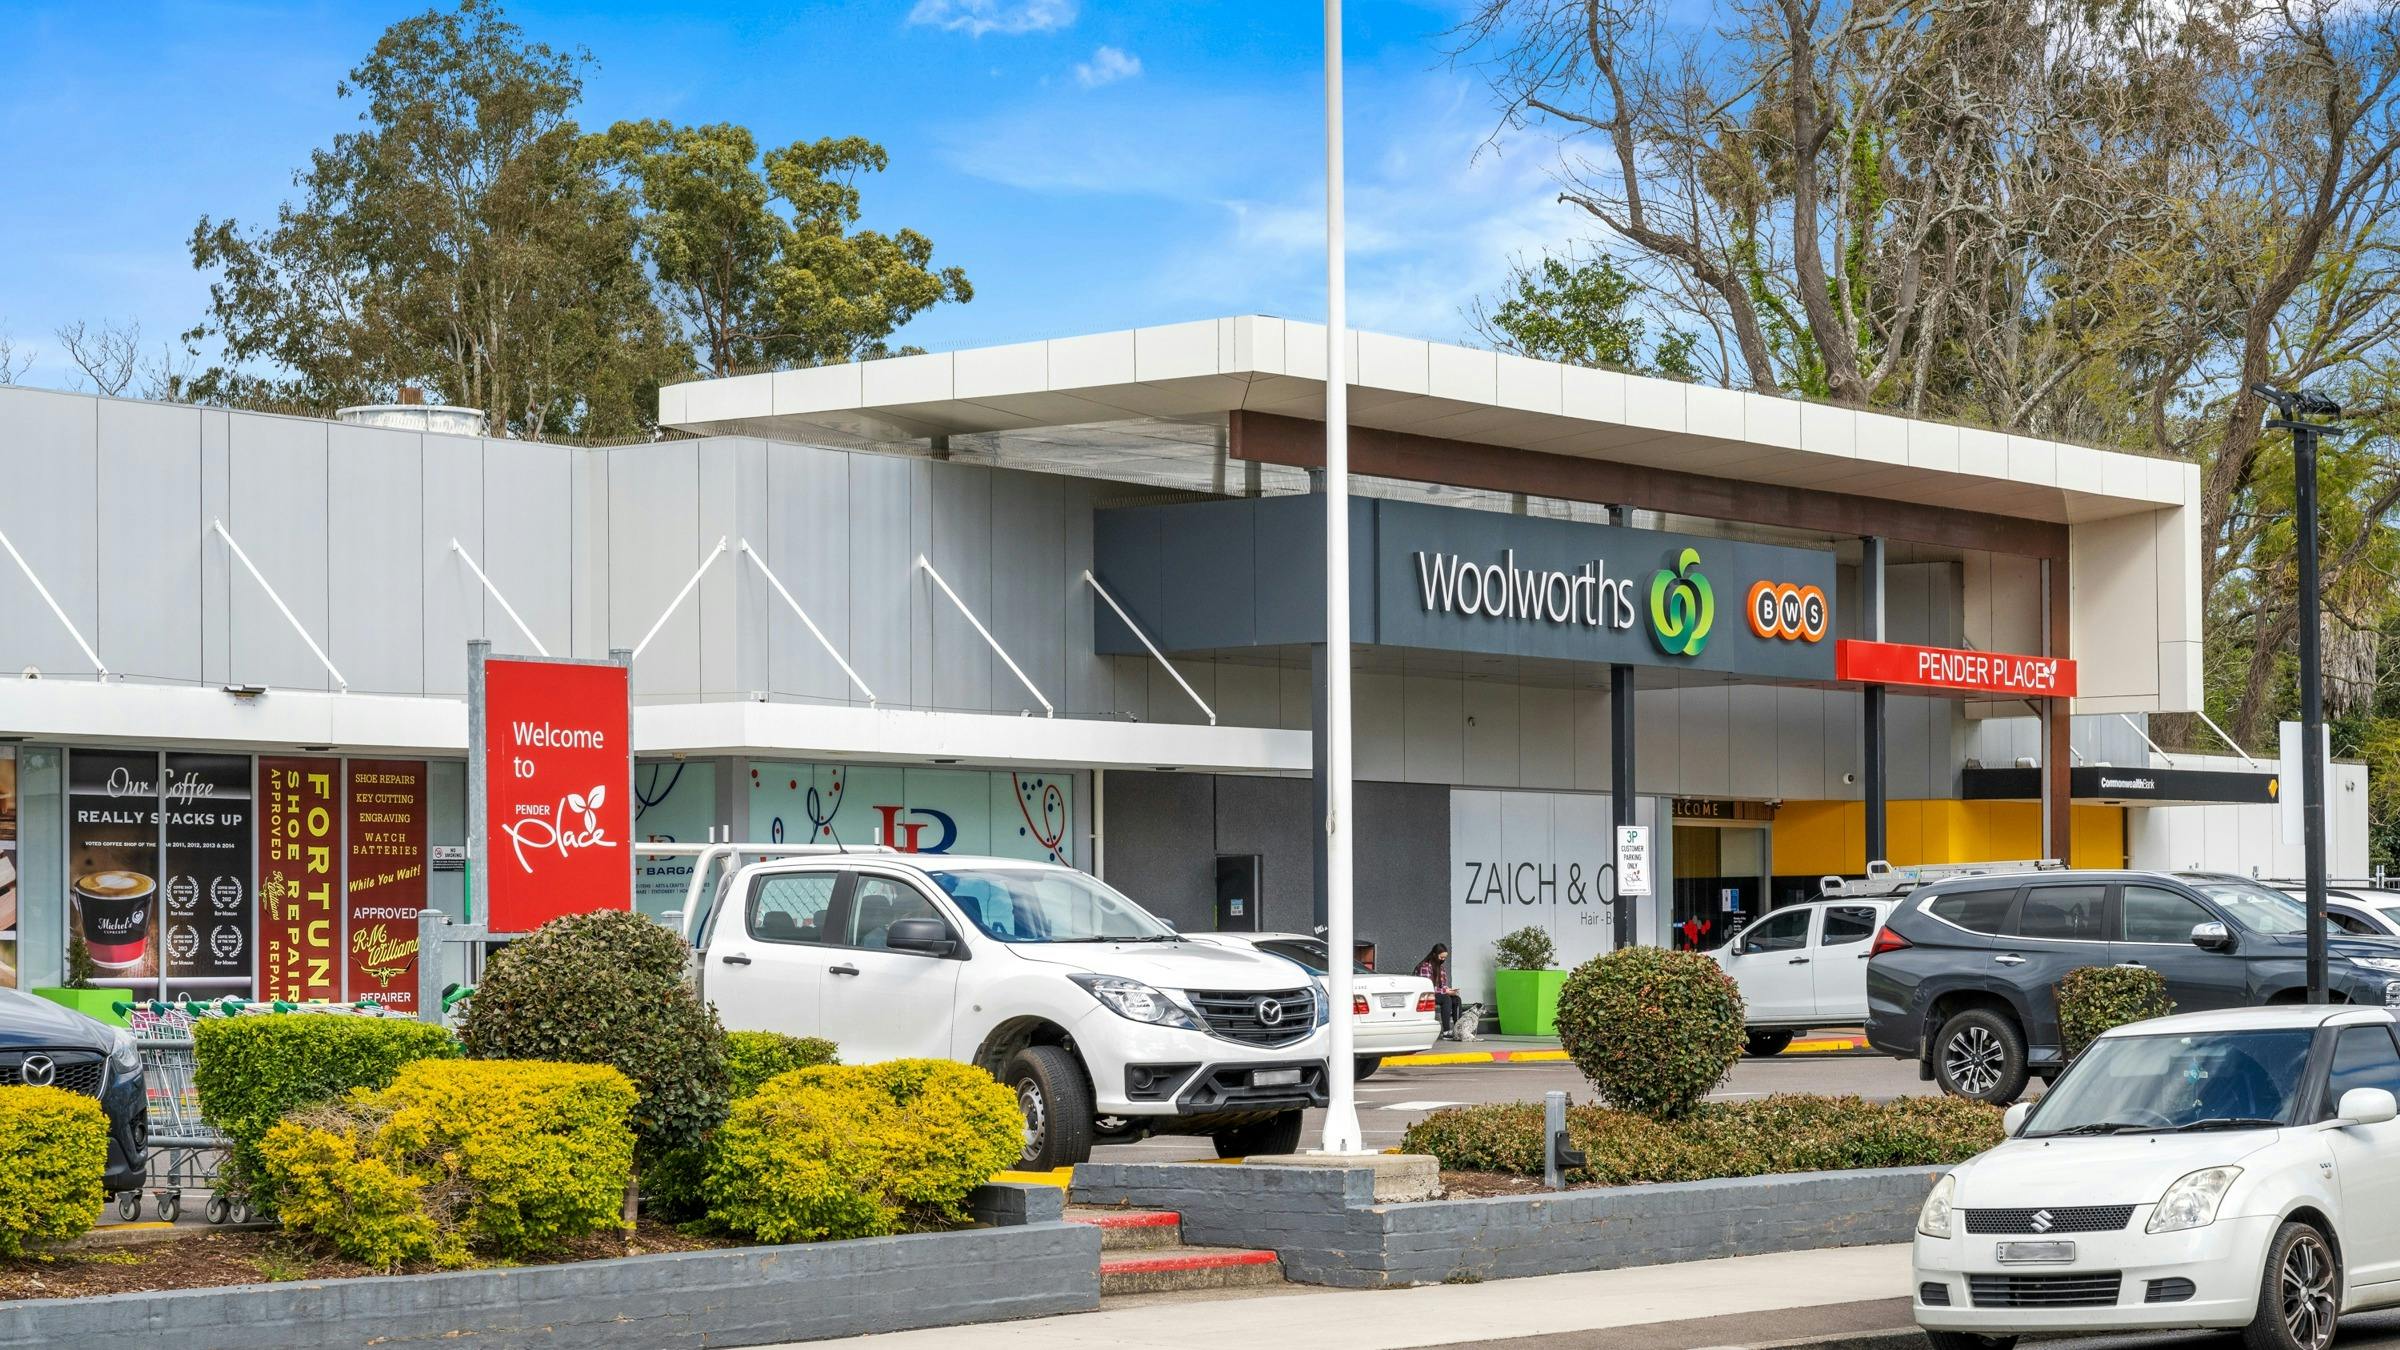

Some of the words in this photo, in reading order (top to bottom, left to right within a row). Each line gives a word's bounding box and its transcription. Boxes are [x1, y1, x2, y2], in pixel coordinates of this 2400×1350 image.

[1416, 549, 1635, 629] Woolworths
[1919, 652, 1989, 684] PENDER
[1994, 659, 2046, 688] PLACE
[512, 721, 604, 749] Welcome
[513, 756, 535, 778] to
[107, 767, 149, 798] Our
[355, 774, 378, 784] SHOE
[380, 774, 415, 785] REPAIRS
[356, 794, 373, 803] KEY
[375, 794, 414, 804] CUTTING
[271, 768, 281, 860] APPROVED
[287, 770, 300, 860] SHOE
[515, 804, 550, 815] PENDER
[78, 810, 144, 824] REALLY
[221, 814, 243, 826] UP
[359, 813, 411, 823] ENGRAVING
[365, 833, 406, 843] WATCH
[353, 845, 418, 855] BATTERIES
[348, 877, 375, 893] While
[378, 873, 394, 886] You
[396, 864, 421, 881] Wait!
[1465, 862, 1557, 905] ZAICH
[1567, 863, 1588, 905] &
[307, 773, 330, 1006] FORTUN
[353, 907, 418, 919] APPROVED
[1580, 911, 1599, 925] Hair
[98, 917, 132, 930] Michel's
[360, 992, 411, 1003] REPAIRER
